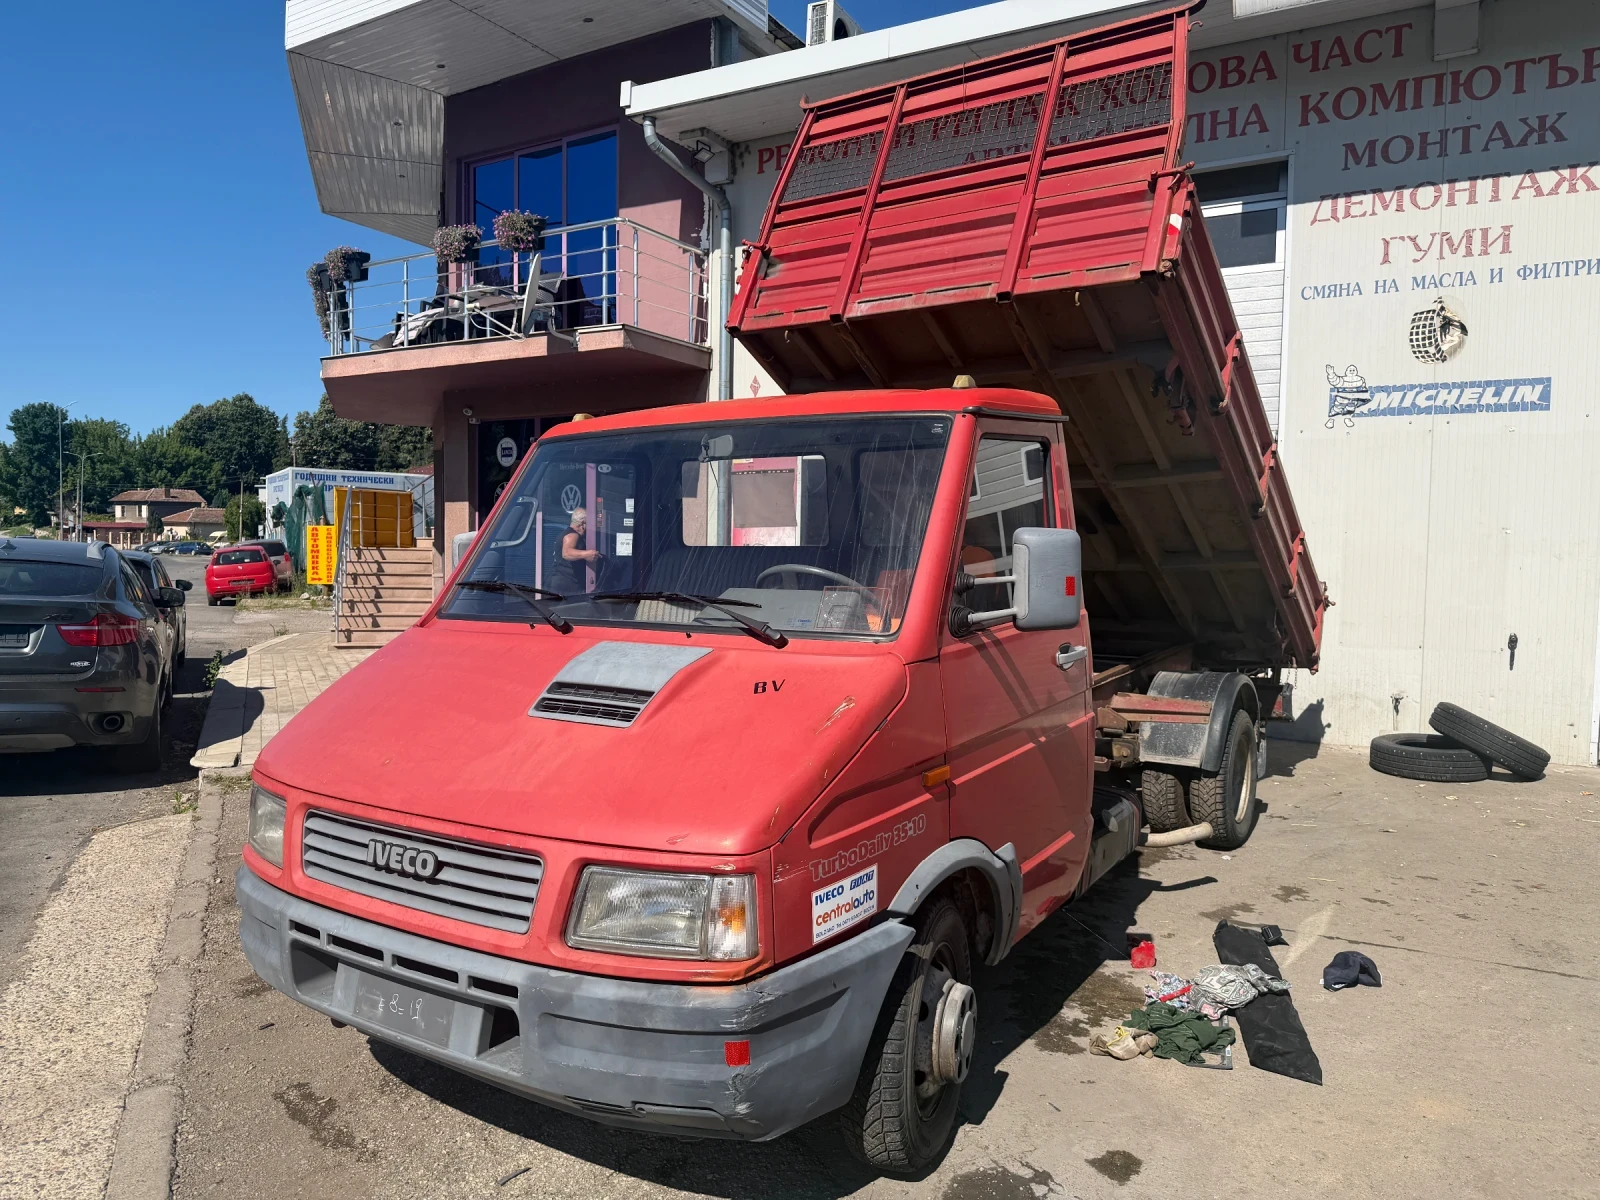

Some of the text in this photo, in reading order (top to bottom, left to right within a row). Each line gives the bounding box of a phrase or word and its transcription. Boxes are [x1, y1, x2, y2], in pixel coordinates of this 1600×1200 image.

[1292, 23, 1413, 73] ЧАСТ
[1341, 111, 1568, 171] МОНТАЖ
[1310, 161, 1600, 226] ДЕМОНТАЖ
[1379, 224, 1514, 266] ГУМИ
[1300, 257, 1600, 301] СМЯНА НА МАСЛА И ФИЛТРИ
[1366, 384, 1544, 410] MICHELIN
[295, 472, 337, 482] ГОДИШНИ
[341, 475, 394, 485] ТЕХНИЧЕСКИ
[311, 527, 320, 576] АВТОМИВКА
[367, 839, 438, 878] IVECO
[809, 832, 892, 882] TurboDaily
[815, 870, 875, 906] IVECO FIAT
[815, 889, 875, 927] centralauto
